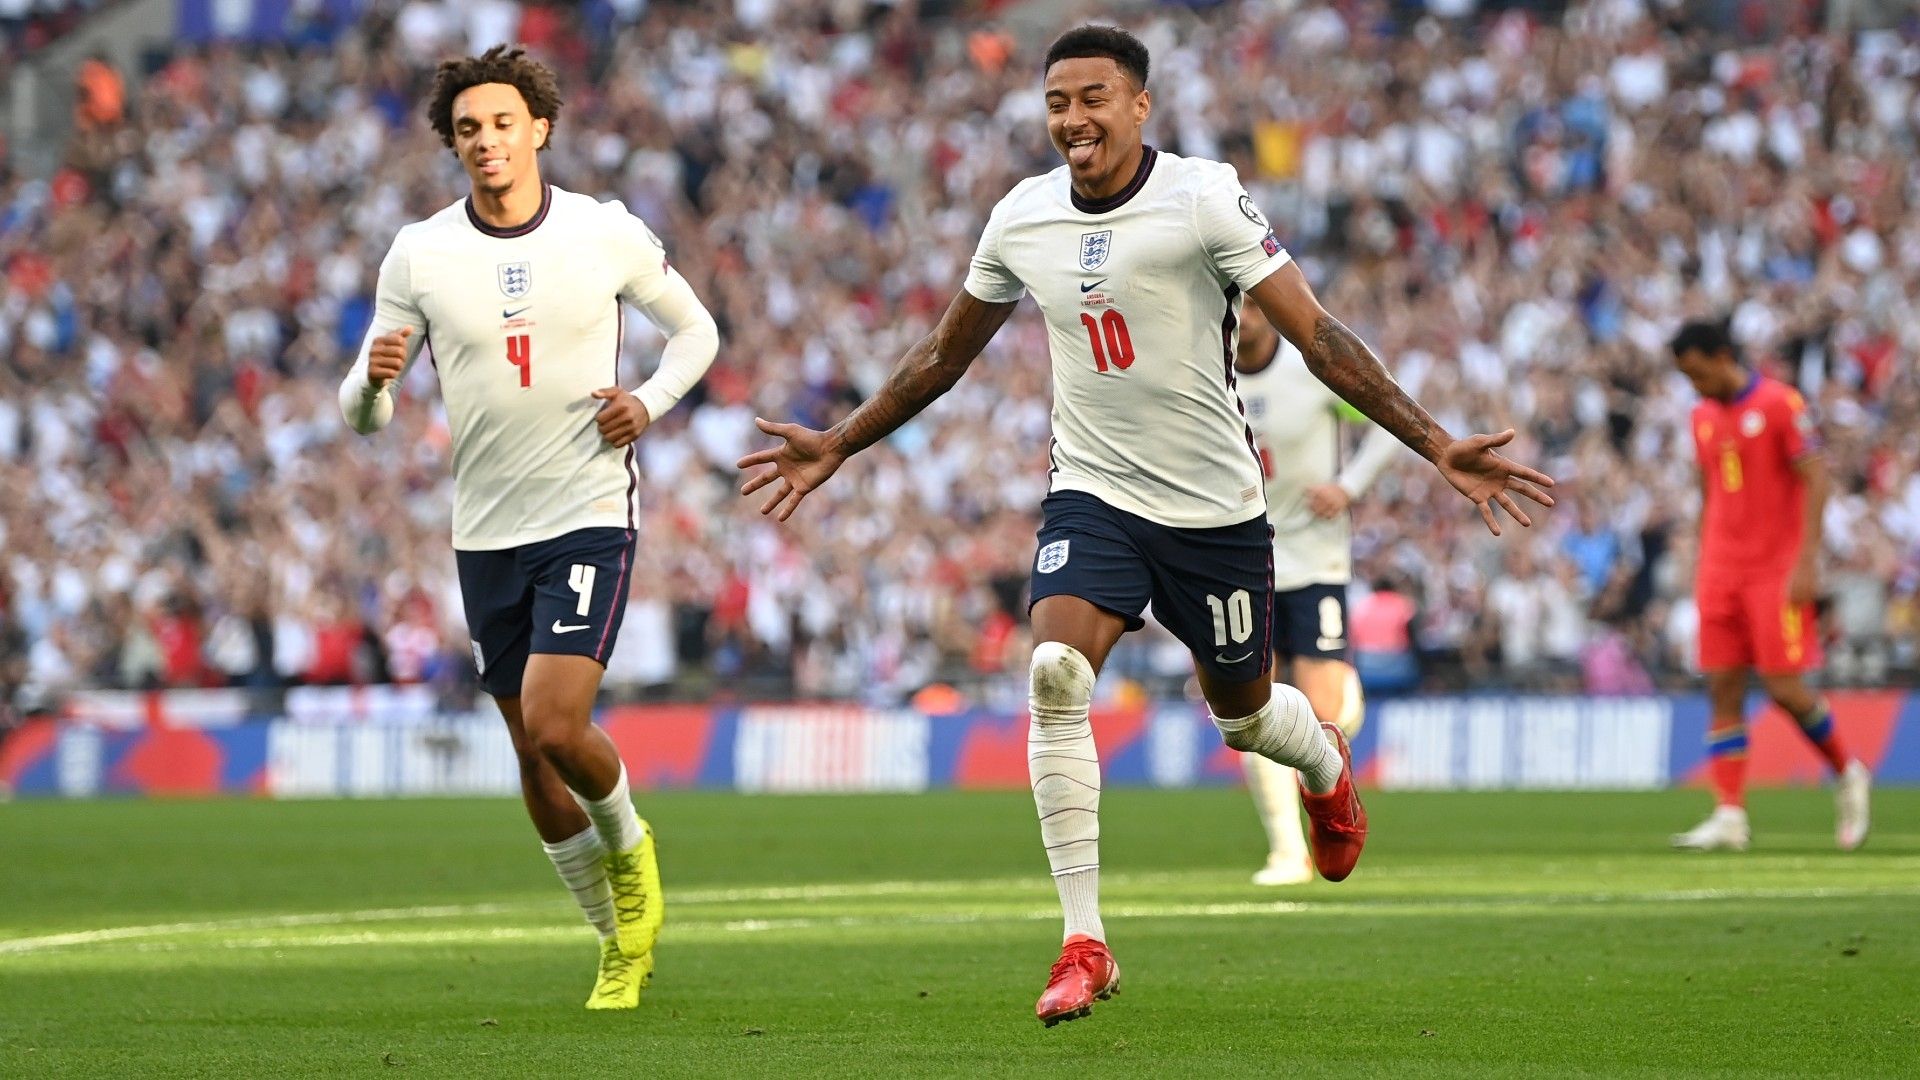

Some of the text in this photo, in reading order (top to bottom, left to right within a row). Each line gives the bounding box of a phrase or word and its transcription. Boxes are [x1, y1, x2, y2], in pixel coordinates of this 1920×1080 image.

[507, 335, 530, 387] 4
[1080, 309, 1135, 372] 10
[568, 564, 596, 616] 4
[1206, 588, 1253, 646] 10
